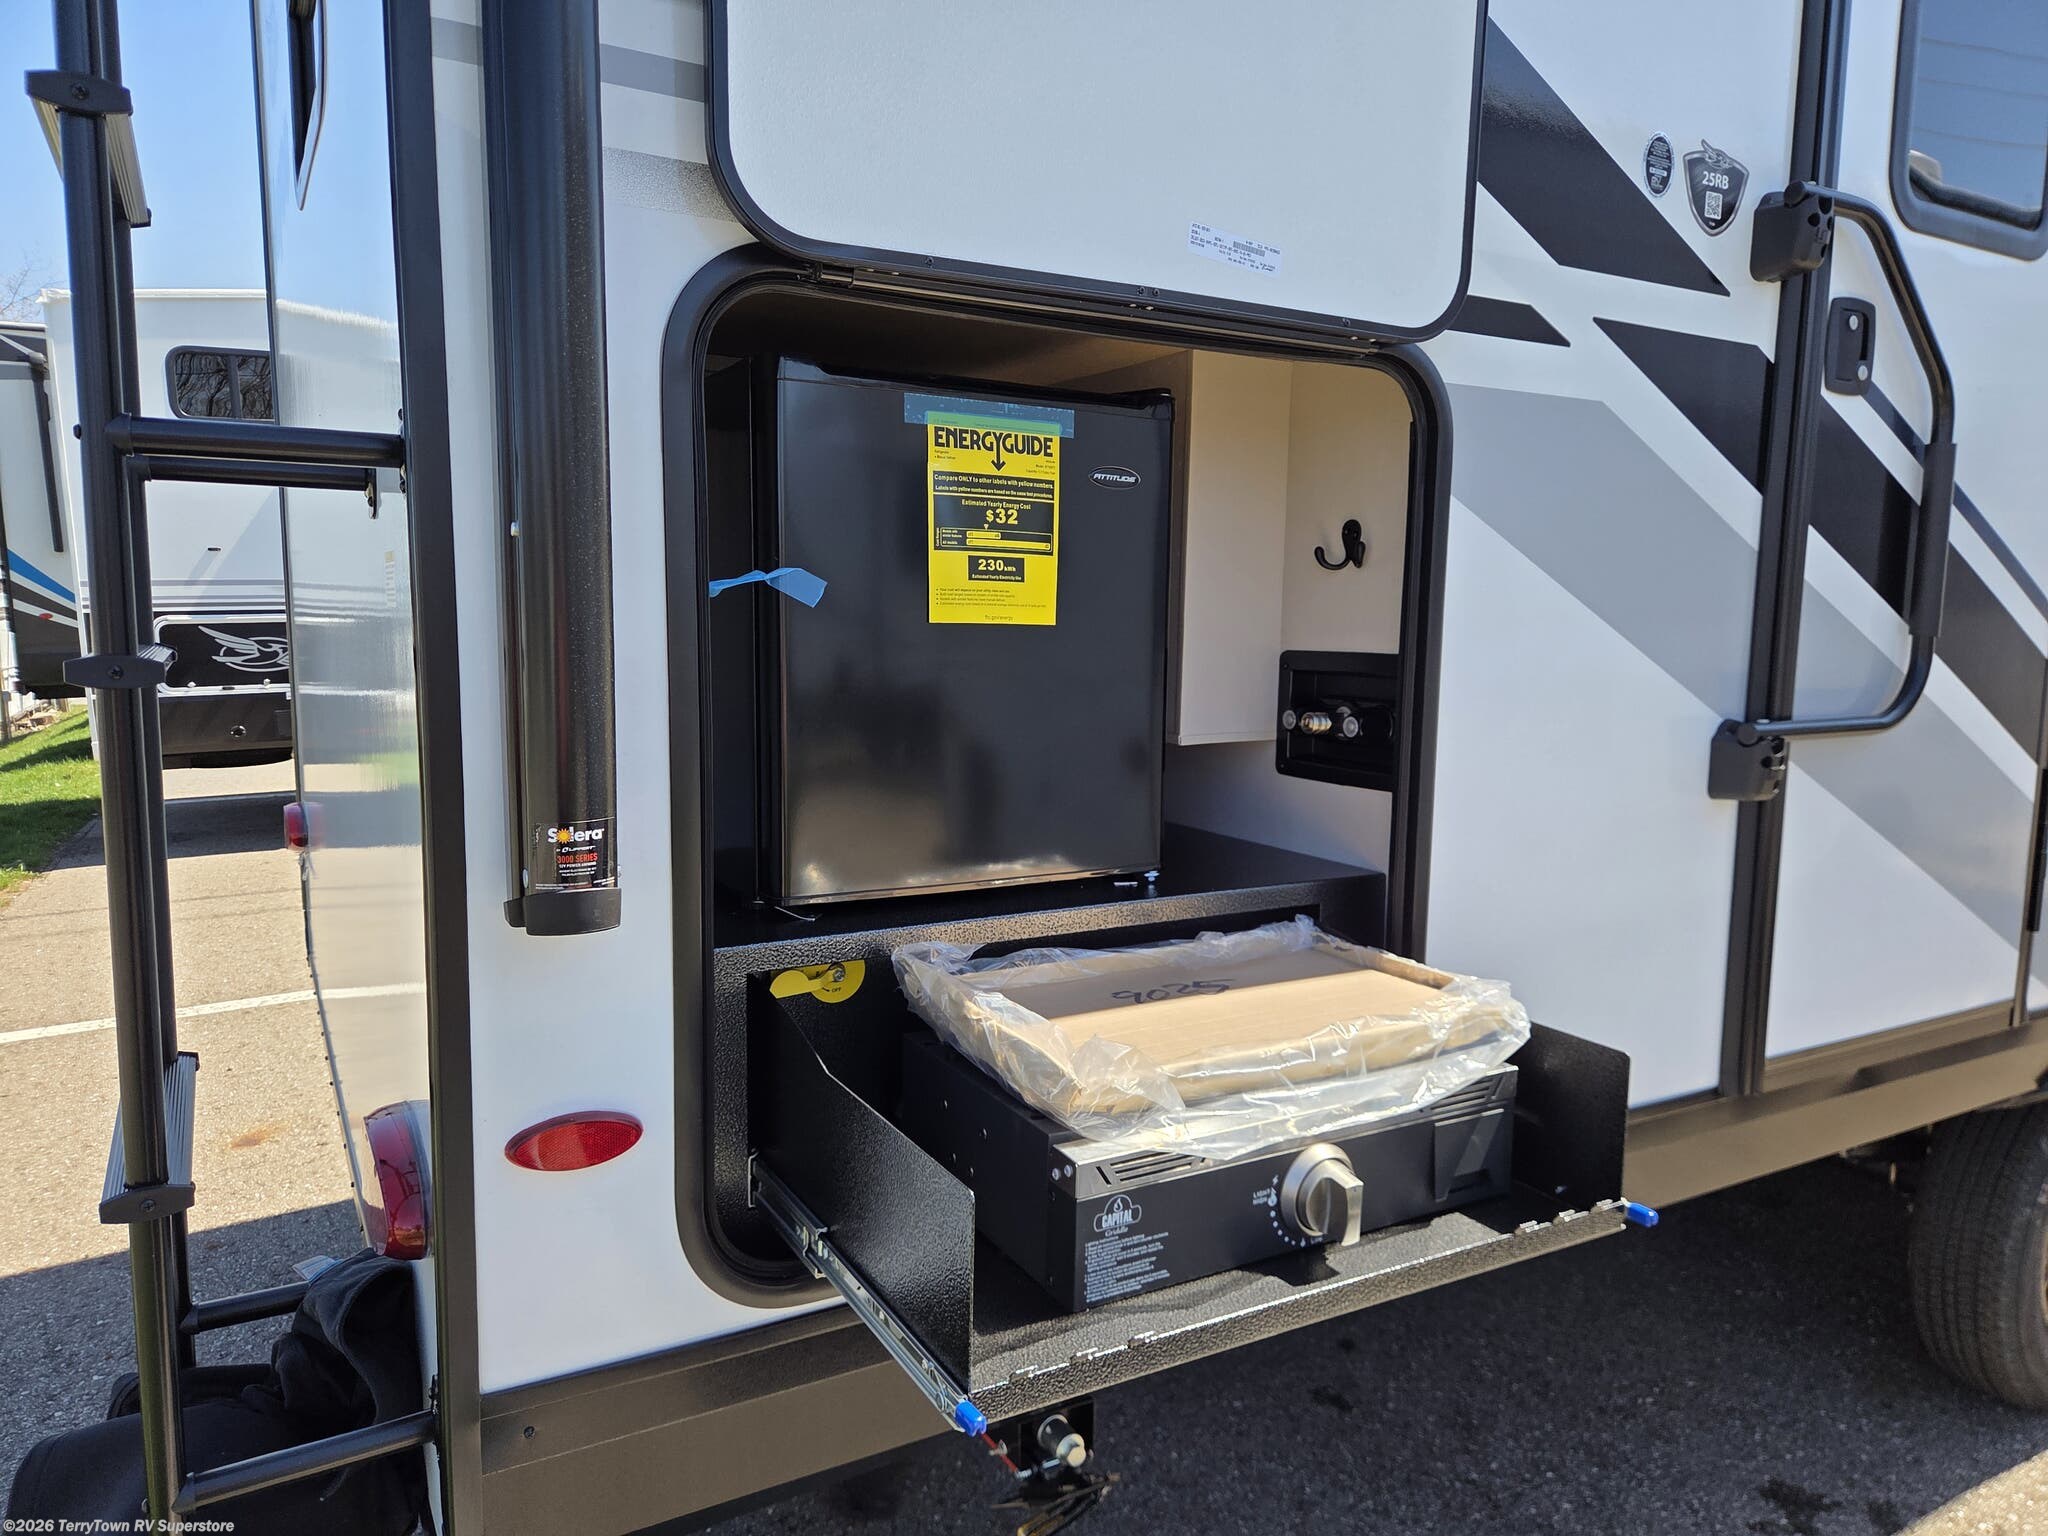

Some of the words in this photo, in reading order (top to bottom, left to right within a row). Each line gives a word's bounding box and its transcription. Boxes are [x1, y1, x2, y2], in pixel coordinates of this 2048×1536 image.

[1702, 171, 1729, 190] 25RB
[933, 425, 1054, 459] ENERGYGUIDE
[934, 473, 958, 482] Compare
[979, 476, 992, 484] other
[992, 477, 1007, 485] labels
[1007, 478, 1018, 486] with
[1018, 479, 1033, 488] yellow
[1093, 473, 1137, 483] ATTITUDE
[961, 498, 987, 507] Estimated
[987, 499, 1002, 509] Yearly
[1002, 501, 1020, 510] Energy
[1020, 502, 1031, 510] Cost
[557, 855, 574, 864] 3000
[575, 852, 598, 863] SERIES
[1111, 978, 1236, 1004] 9025
[1101, 1208, 1133, 1229] CAPITAL
